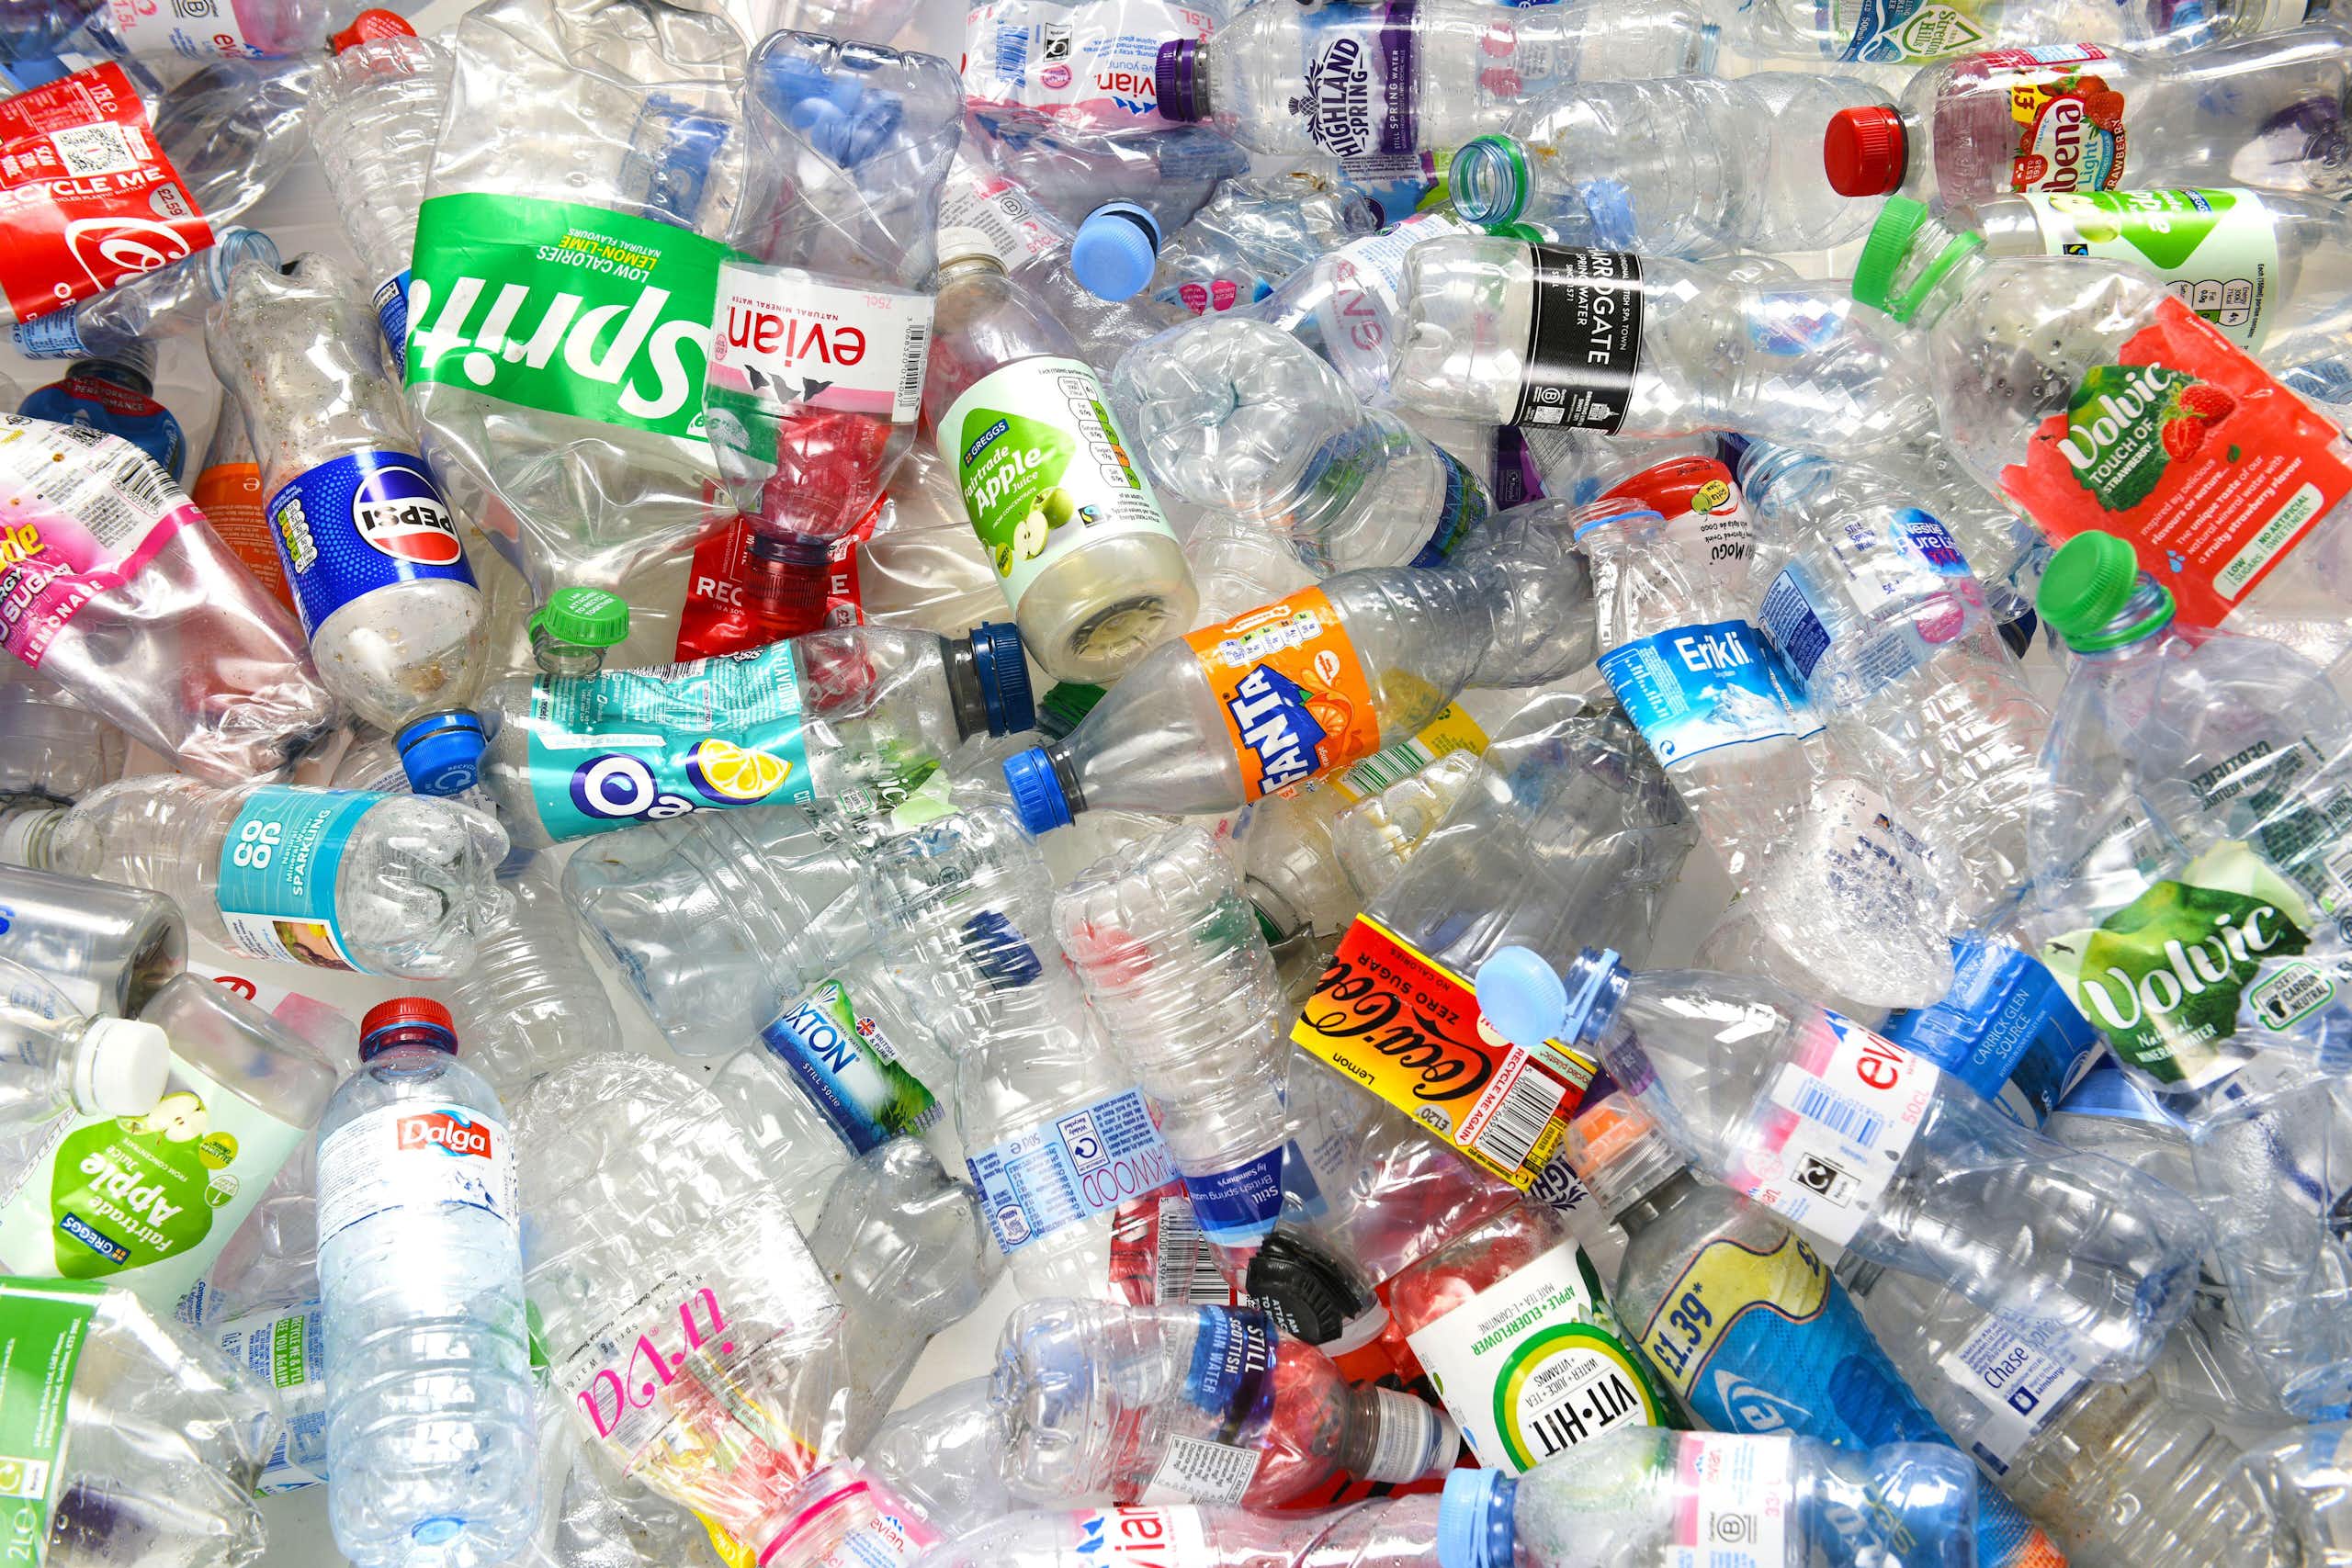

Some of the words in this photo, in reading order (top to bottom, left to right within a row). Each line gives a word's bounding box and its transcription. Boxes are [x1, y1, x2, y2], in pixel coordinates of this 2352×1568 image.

[1913, 20, 1932, 48] Hills
[1924, 10, 1950, 56] Stretton
[1321, 38, 1363, 159] HIGHLAND
[1349, 71, 1369, 137] SPRING
[1389, 80, 1398, 130] SPRING
[2013, 86, 2035, 111] £1
[1393, 127, 1401, 150] STILL
[119, 166, 166, 189] ME
[2031, 158, 2043, 181] 1938
[2077, 140, 2100, 185] Light
[559, 234, 659, 272] LEMON-LIME
[568, 227, 617, 247] FLAVOURS
[619, 241, 662, 258] NATURAL
[537, 244, 613, 276] CALORIES
[616, 265, 651, 284] LOW
[797, 308, 840, 321] NATURAL
[1577, 288, 1589, 326] WATER
[1623, 307, 1632, 321] SPA
[1620, 323, 1630, 352] TOWN
[2056, 361, 2172, 470] Volvic
[969, 421, 1007, 457] GREGGS
[2087, 436, 2137, 487] TOUCH
[2133, 416, 2157, 444] OF
[974, 446, 1044, 518] Apple
[1012, 470, 1039, 495] Juice
[2101, 441, 2154, 497] STRAWBERRY
[2241, 472, 2268, 501] water
[2264, 454, 2286, 479] with
[360, 504, 456, 536] PEPSI
[2190, 500, 2221, 535] unique
[2229, 487, 2277, 535] strawberry
[2268, 494, 2311, 537] ARTIFICIAL
[2226, 557, 2247, 579] LOW
[3, 561, 74, 624] SUGAR
[582, 593, 609, 608] RECYCLE
[584, 597, 616, 616] TOGETHER
[24, 577, 105, 661] LEMONADE
[1673, 631, 1748, 672] Erikli
[1231, 668, 1309, 795] FANTA
[281, 829, 299, 865] Natural
[286, 845, 302, 884] Mineral
[296, 817, 315, 845] Water
[292, 808, 332, 897] SPARKLING
[1356, 951, 1413, 998] SUGAR
[1389, 948, 1435, 984] CALORIES
[2080, 905, 2280, 1031] Volvic
[1434, 979, 1452, 992] NO
[2283, 974, 2318, 1005] CARBON
[2290, 987, 2328, 1013] NEUTRAL
[1415, 992, 1461, 1027] ZERO
[1973, 1019, 2012, 1066] CARRICK
[2005, 987, 2031, 1023] GLEN
[874, 1042, 889, 1060] PURE
[875, 1032, 896, 1057] BRITISH
[1995, 1011, 2032, 1060] SOURCE
[800, 1061, 821, 1085] STILL
[1331, 1051, 1376, 1087] Lemon
[1498, 1045, 1525, 1090] RECYCLE
[1483, 1089, 1501, 1110] ME
[401, 1119, 486, 1154] Dalga
[1062, 1116, 1088, 1133] Recycled
[1068, 1124, 1089, 1137] Widely
[1459, 1106, 1487, 1143] AGAIN
[105, 1144, 140, 1171] Juice
[1254, 1162, 1269, 1175] by
[79, 1152, 185, 1229] Apple
[165, 1166, 189, 1184] FROM
[1238, 1175, 1274, 1194] British
[1207, 1184, 1240, 1202] spring
[1251, 1185, 1280, 1205] Still
[62, 1215, 115, 1257] GREGGS
[87, 1194, 174, 1254] Fairtrade
[1545, 1284, 1577, 1309] APPLE
[274, 1334, 288, 1352] YOU
[276, 1319, 288, 1333] SEE
[289, 1316, 301, 1344] RECYCLE
[1470, 1307, 1544, 1358] ELDERFLOWER
[288, 1345, 300, 1358] ME
[1224, 1315, 1243, 1375] SCOTTISH
[1244, 1324, 1265, 1374] STILL
[274, 1353, 289, 1387] AGAIN!
[1202, 1349, 1223, 1395] WATER
[1533, 1362, 1569, 1389] VITAMINS
[1549, 1371, 1575, 1396] JUICE
[1575, 1357, 1600, 1382] WATER
[1983, 1345, 2030, 1391] Chase
[1525, 1389, 1544, 1409] TEA
